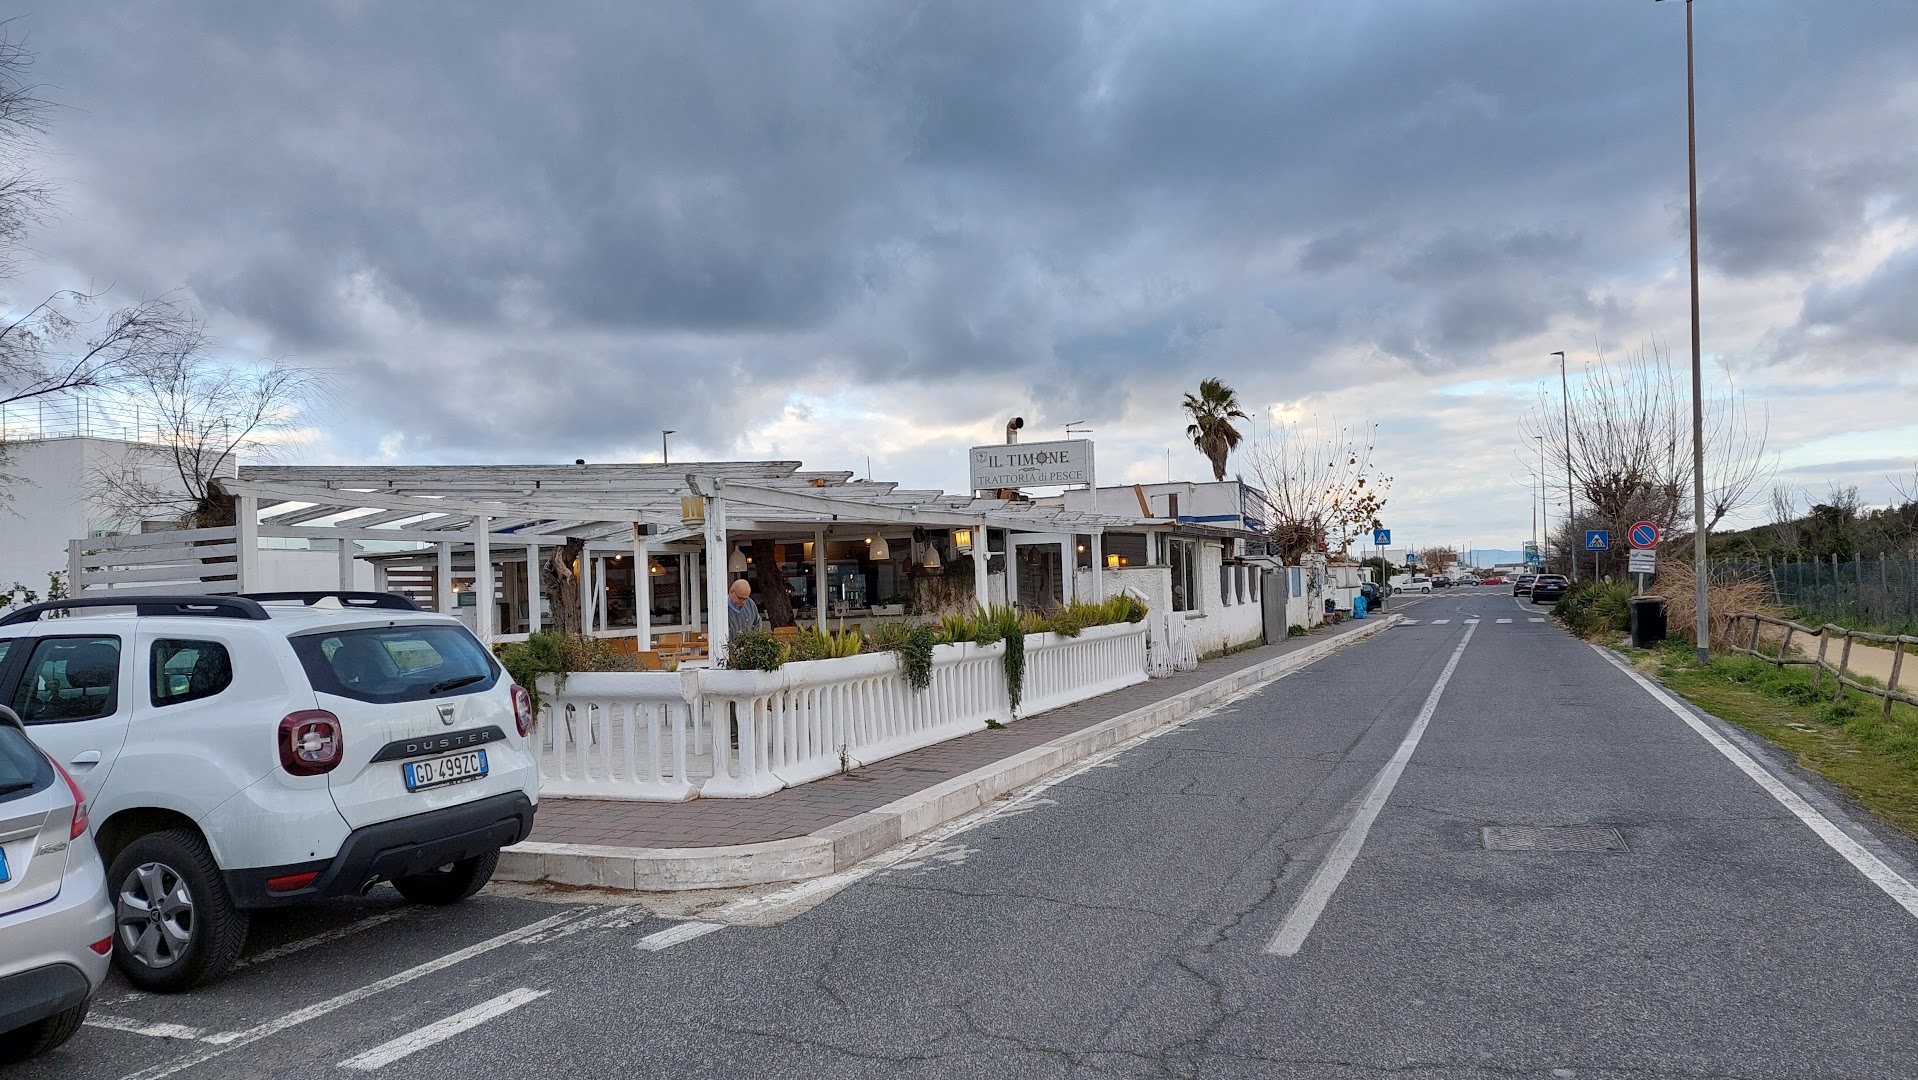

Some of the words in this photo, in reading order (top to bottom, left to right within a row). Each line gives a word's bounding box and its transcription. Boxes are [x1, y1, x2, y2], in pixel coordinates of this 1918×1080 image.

[988, 455, 1003, 468] IL
[1007, 450, 1069, 466] TIMONE
[978, 473, 1036, 485] TRATTORIA
[1038, 471, 1047, 481] di
[1050, 470, 1083, 481] PESCE
[406, 731, 490, 753] DUSTER
